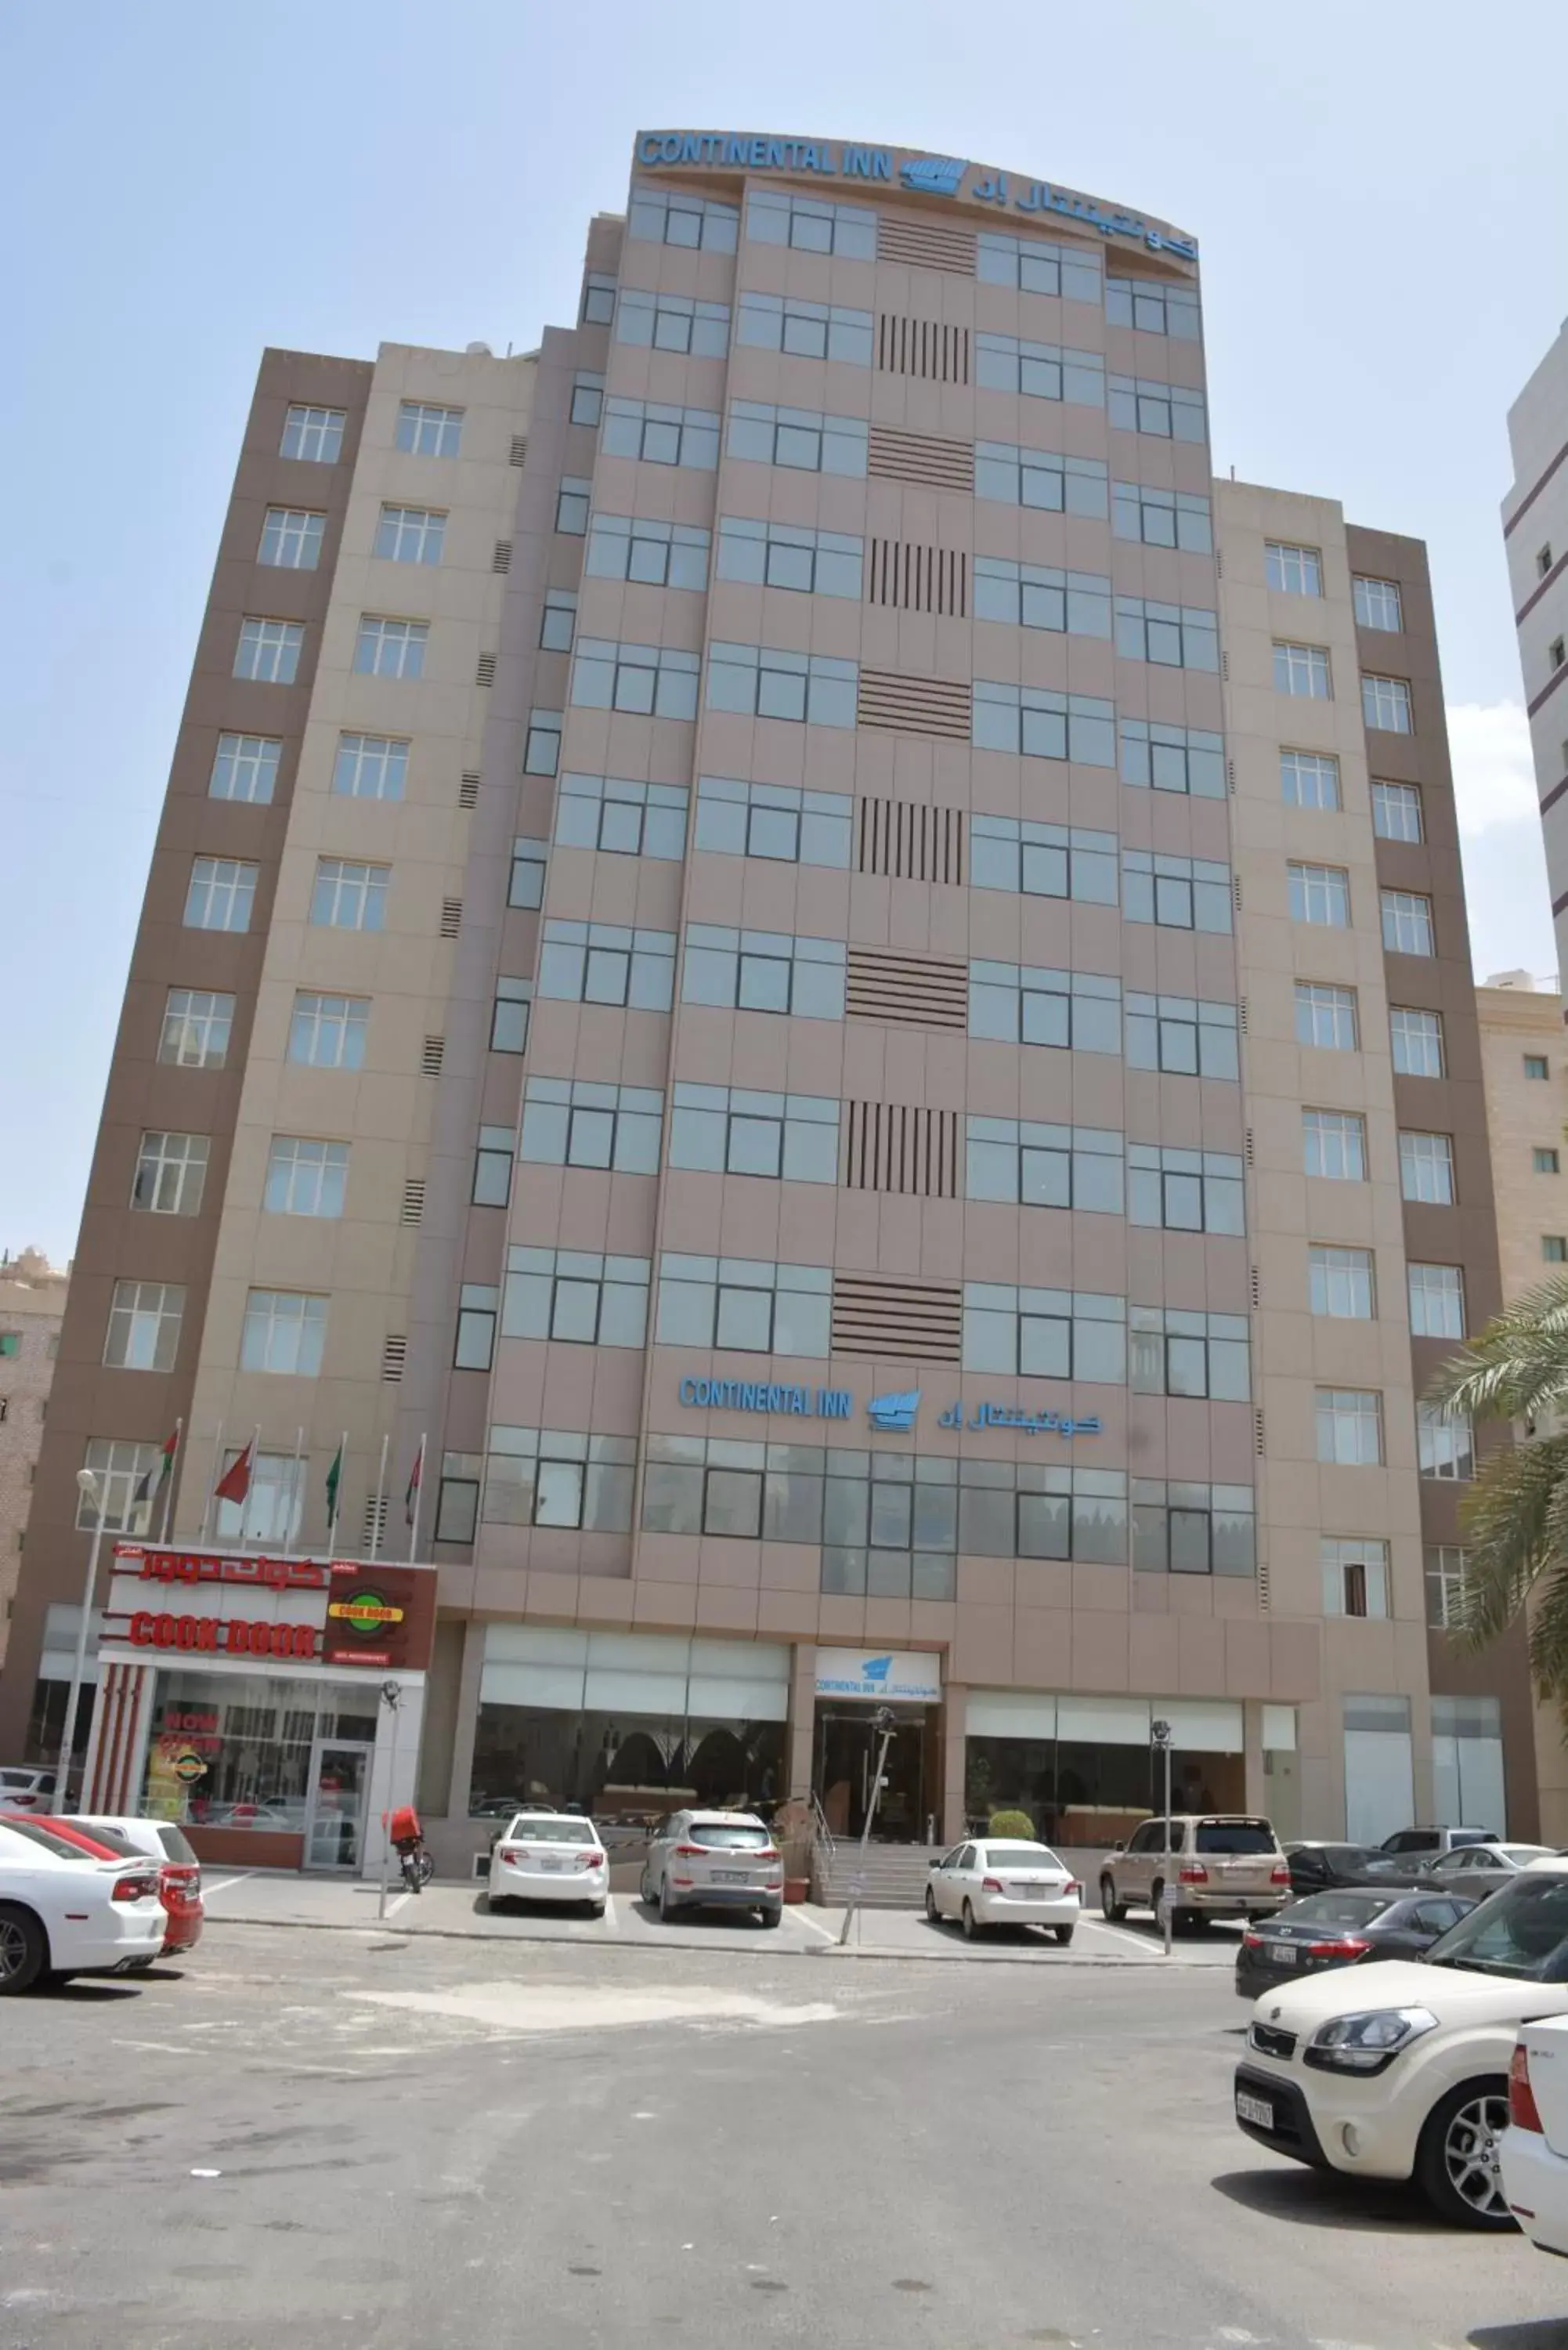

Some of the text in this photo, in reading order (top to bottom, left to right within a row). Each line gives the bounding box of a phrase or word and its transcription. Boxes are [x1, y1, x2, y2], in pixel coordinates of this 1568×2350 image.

[638, 134, 894, 180] CONTINENTAL INN
[679, 1376, 852, 1419] CONTINENTAL INN
[129, 1611, 315, 1658] COOK DOOR
[164, 1712, 219, 1731] NOW
